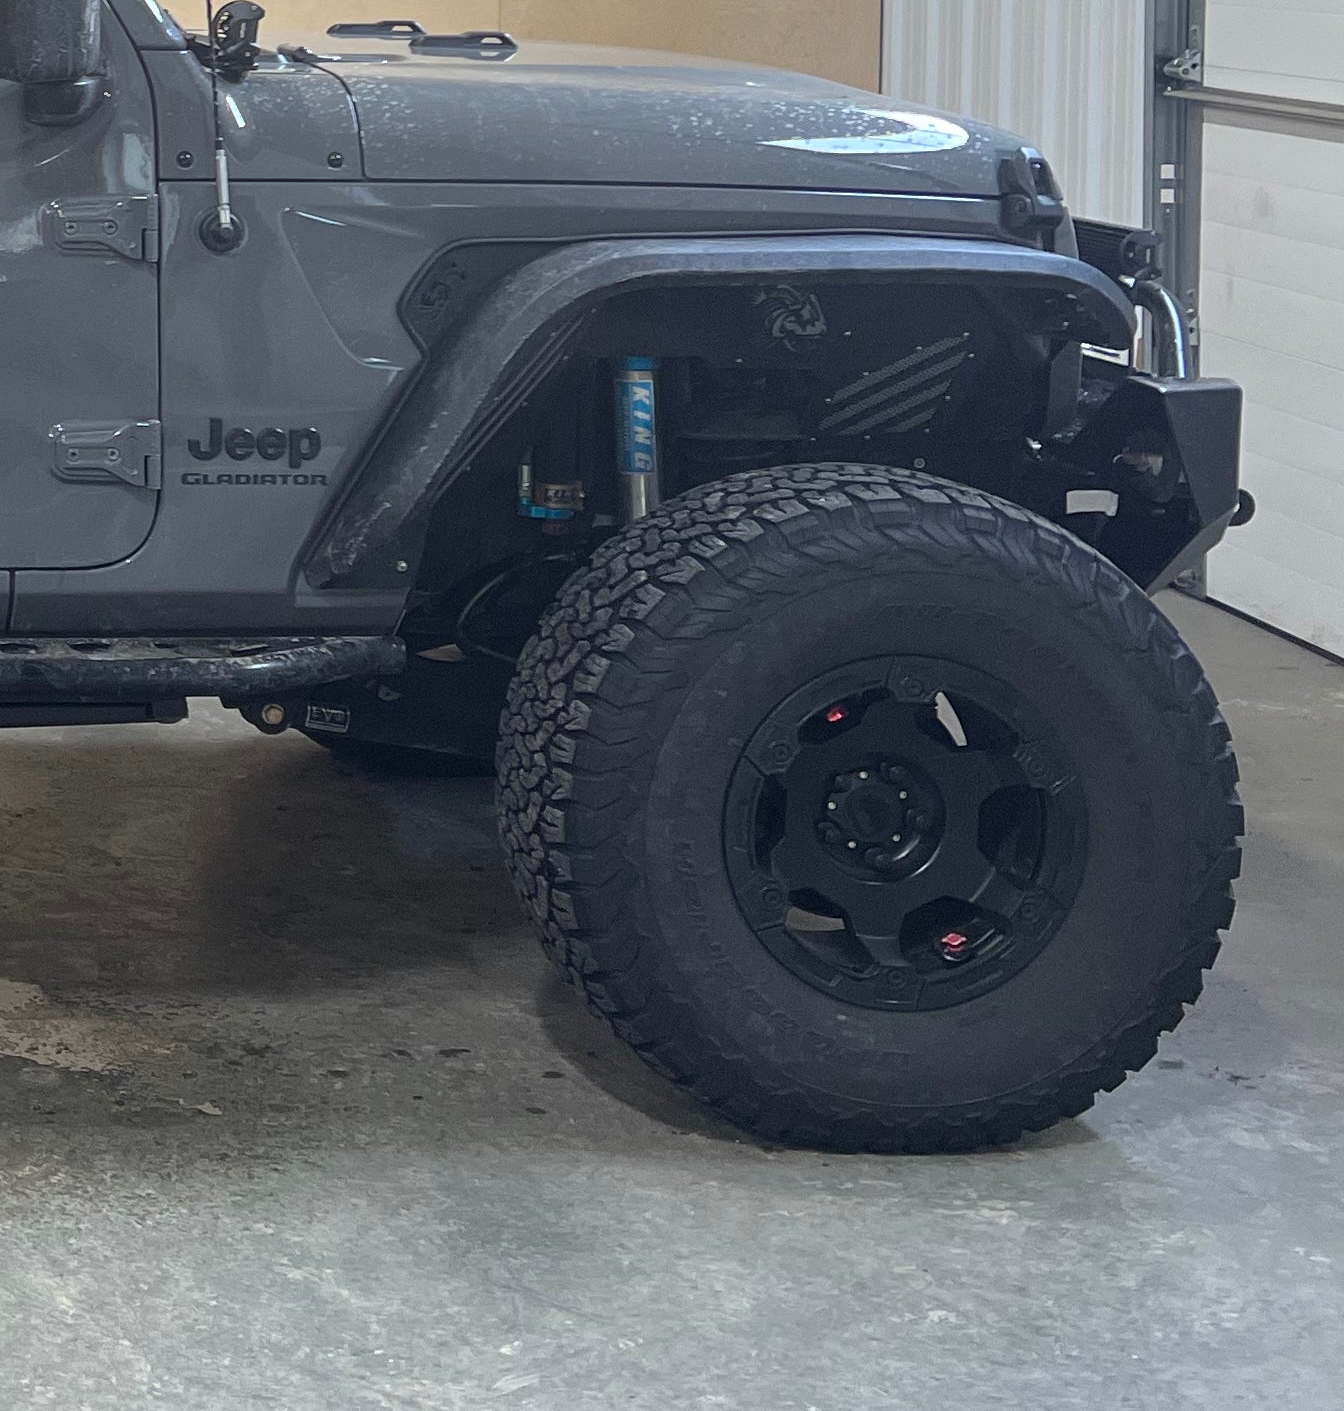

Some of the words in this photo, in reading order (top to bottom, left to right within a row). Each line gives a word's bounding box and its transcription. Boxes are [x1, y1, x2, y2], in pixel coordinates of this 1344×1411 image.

[188, 417, 322, 469] Jeep
[632, 386, 652, 471] KING
[181, 473, 329, 486] GLADIATOR
